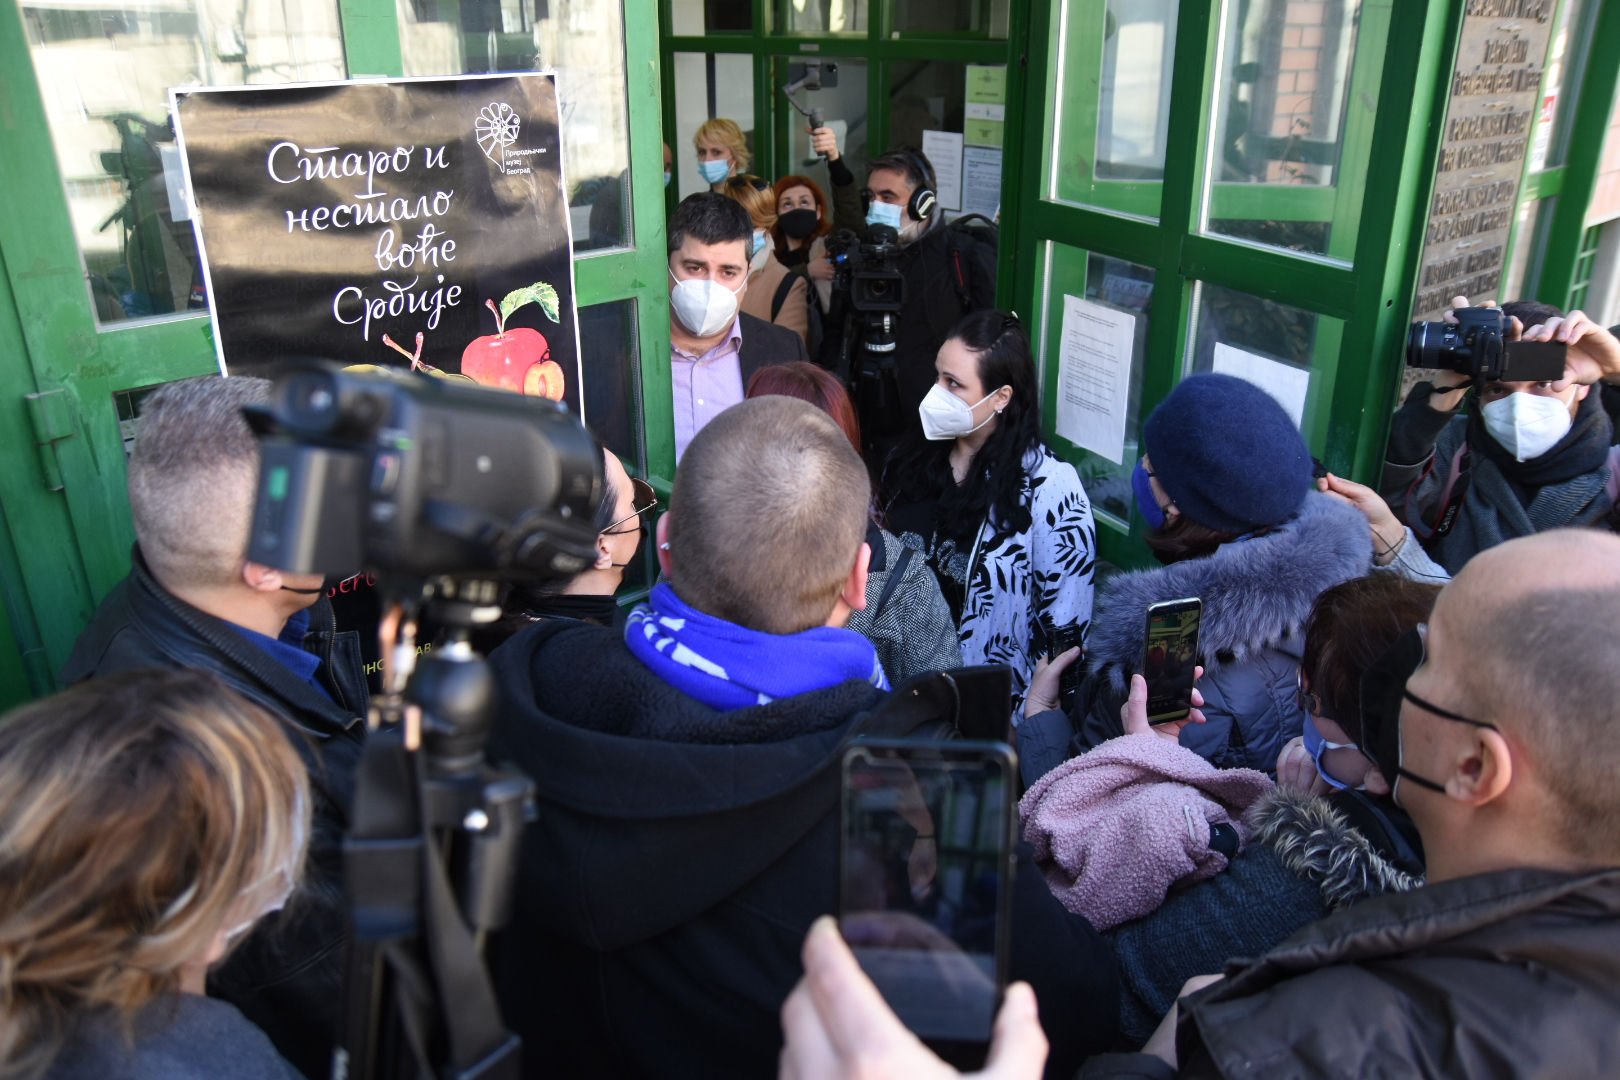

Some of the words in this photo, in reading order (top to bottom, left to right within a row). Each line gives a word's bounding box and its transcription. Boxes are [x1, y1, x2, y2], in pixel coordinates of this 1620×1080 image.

[267, 141, 415, 194] Старо
[425, 143, 450, 169] и
[286, 188, 454, 233] нестало
[373, 223, 457, 271] воће
[332, 274, 463, 342] Србије
